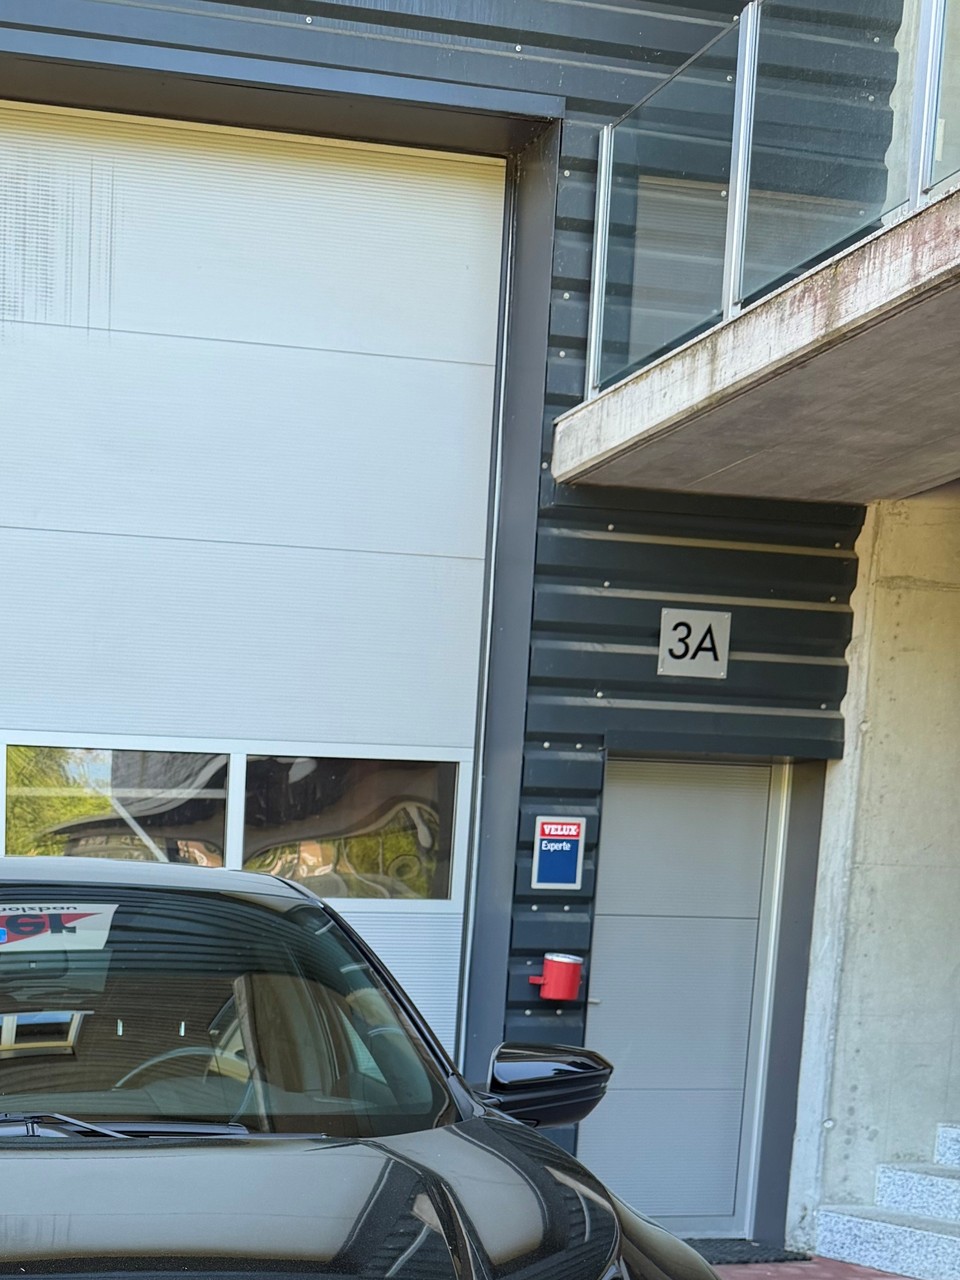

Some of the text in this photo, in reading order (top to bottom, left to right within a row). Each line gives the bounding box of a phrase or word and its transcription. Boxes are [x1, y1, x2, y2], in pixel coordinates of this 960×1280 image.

[668, 621, 719, 661] 3A
[543, 824, 578, 836] VELUX
[541, 840, 571, 853] Experte
